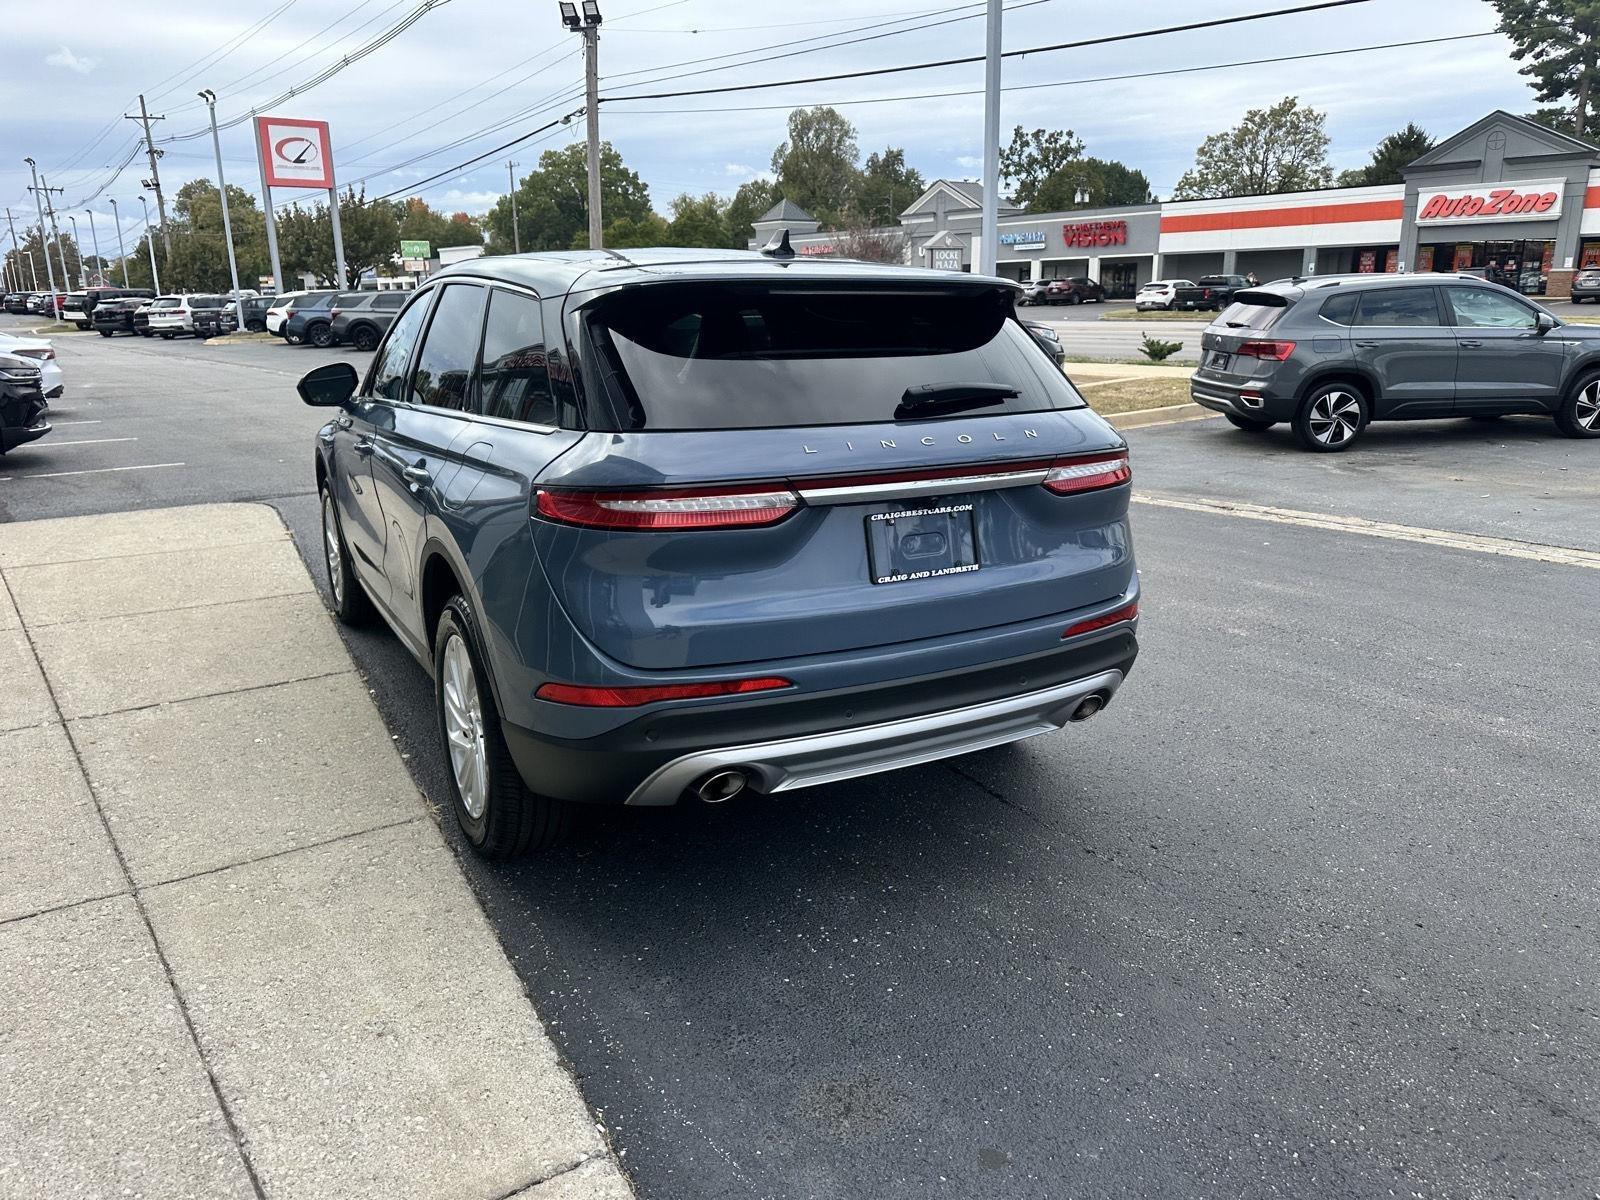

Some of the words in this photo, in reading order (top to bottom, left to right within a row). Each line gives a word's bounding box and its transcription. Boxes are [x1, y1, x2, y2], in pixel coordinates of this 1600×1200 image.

[1419, 189, 1558, 219] AutoZone
[1063, 232, 1126, 247] VISION
[935, 250, 959, 260] LOCKE
[935, 260, 959, 269] PLAZA
[803, 428, 1038, 454] LINCOLN
[871, 504, 973, 521] CRAIGSBESTCARS.COM
[878, 574, 908, 584] CRAIG
[909, 570, 930, 580] AND
[931, 564, 979, 577] LANDRETH
